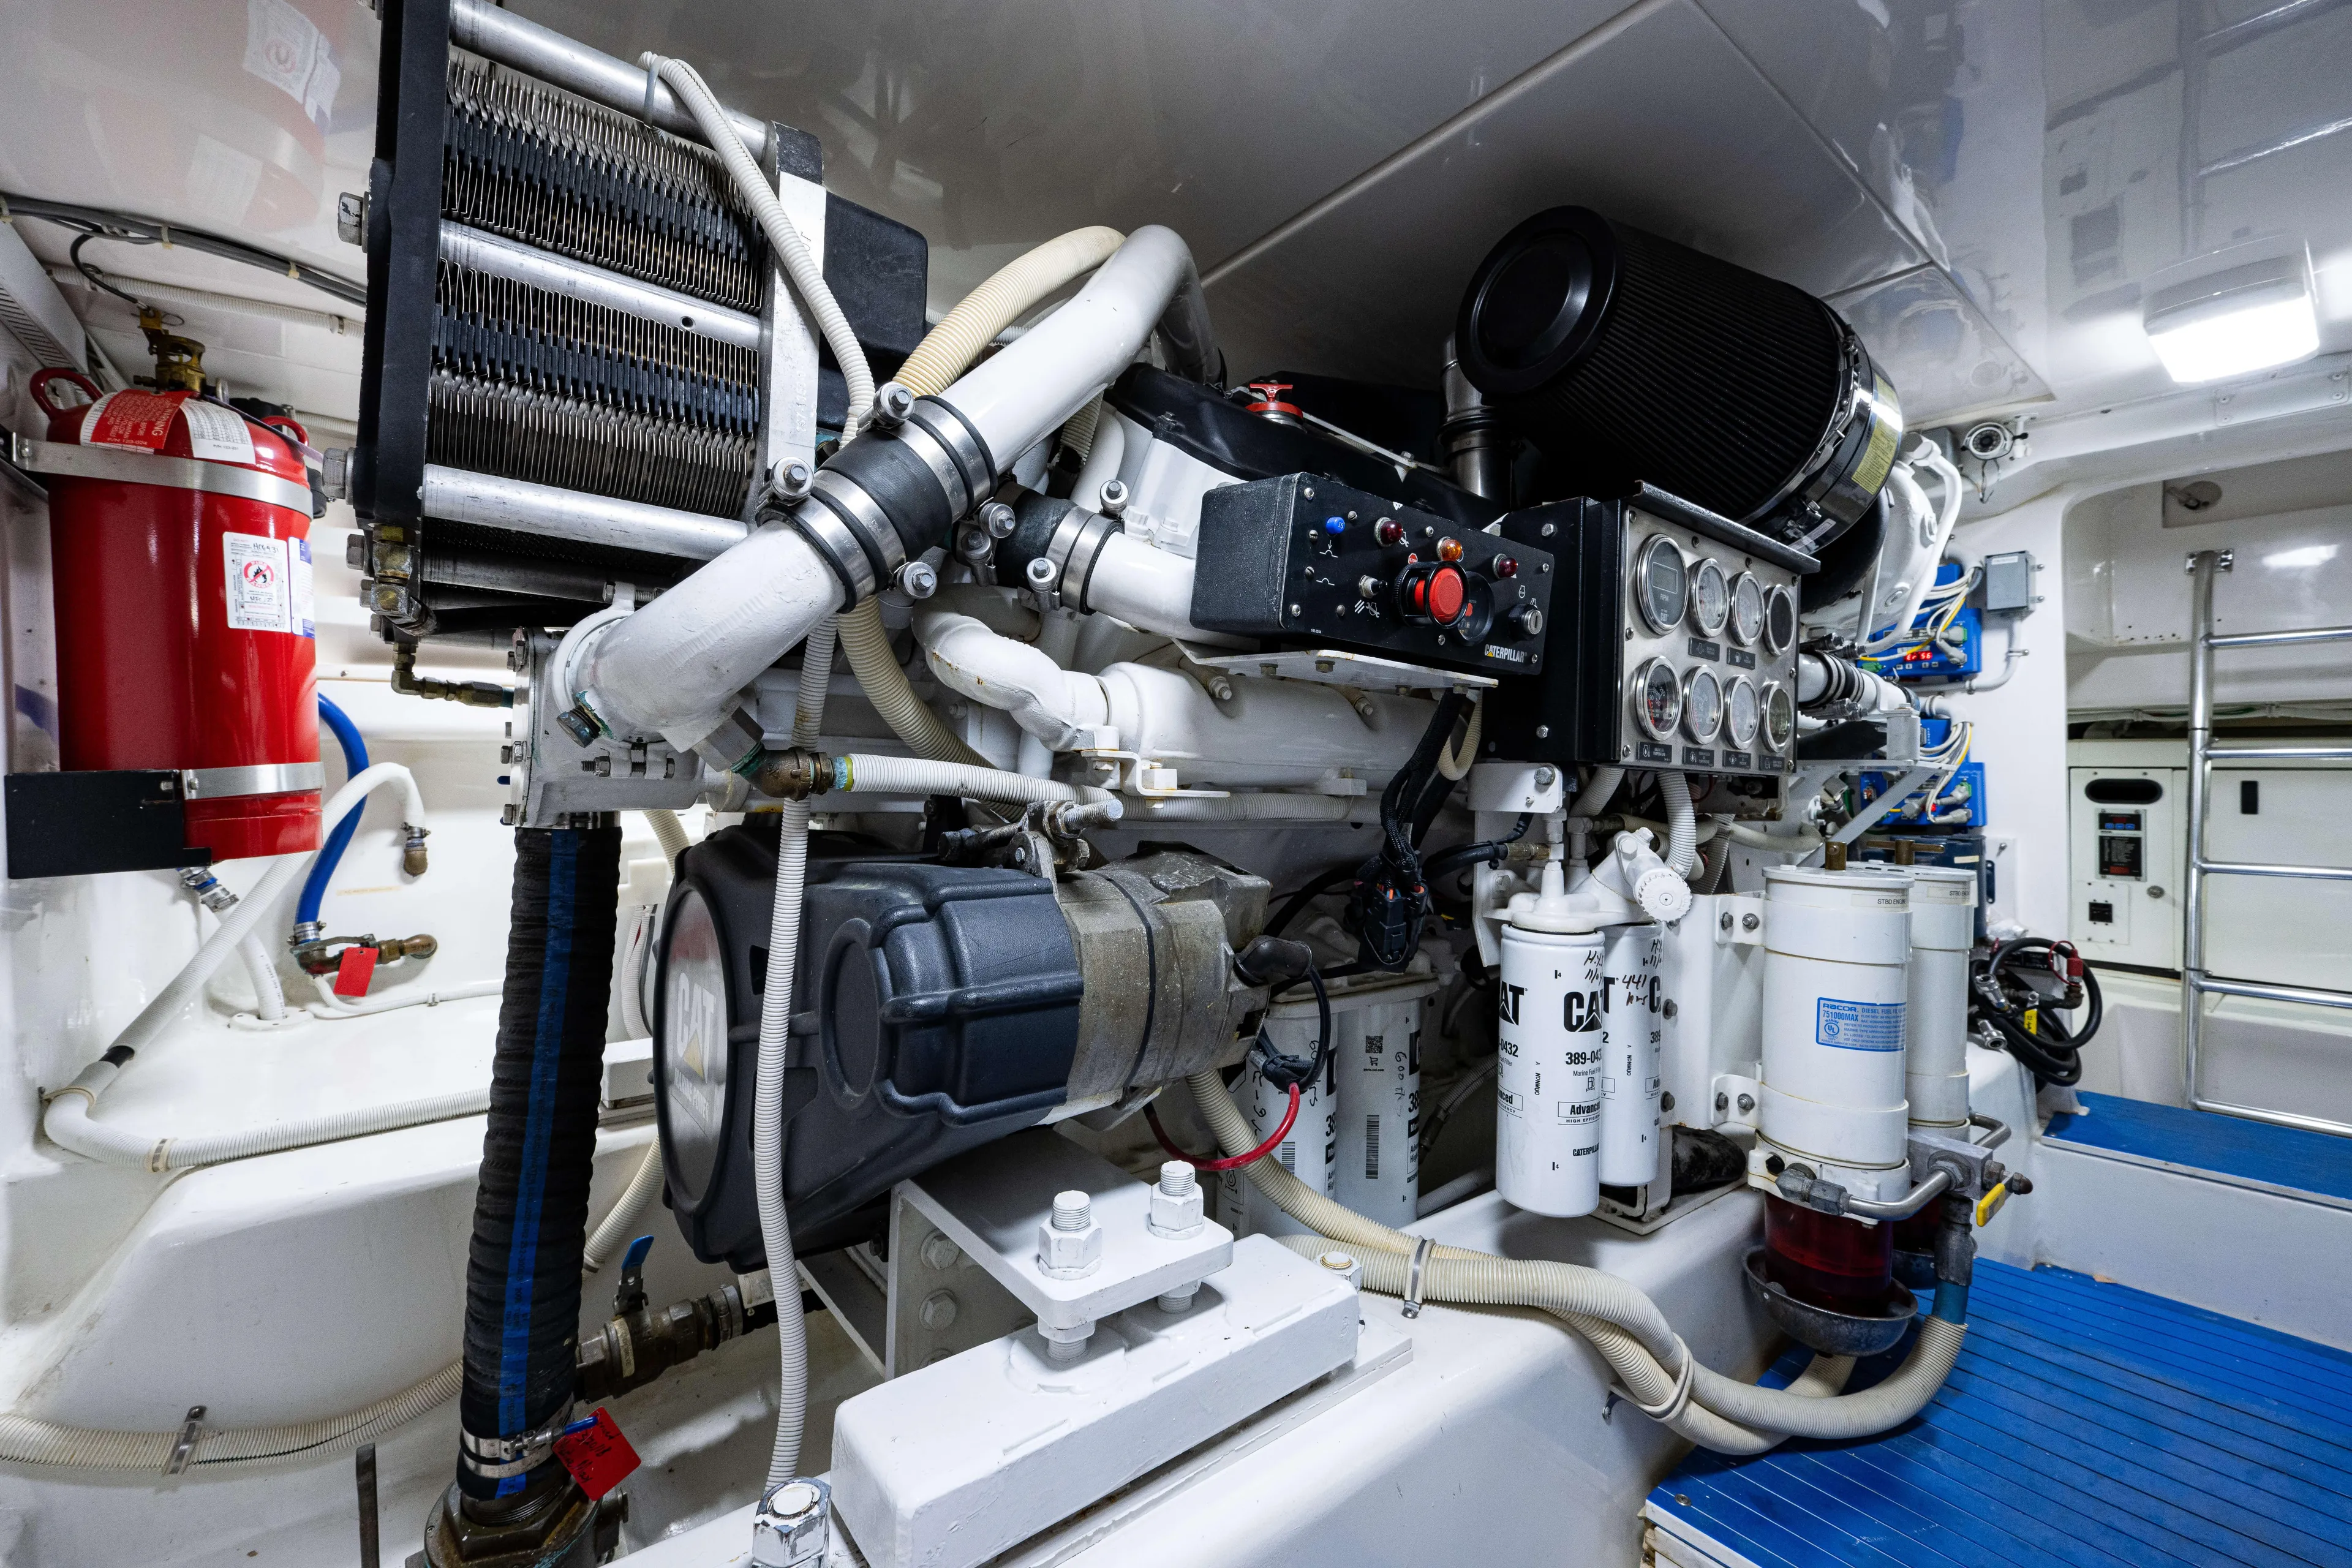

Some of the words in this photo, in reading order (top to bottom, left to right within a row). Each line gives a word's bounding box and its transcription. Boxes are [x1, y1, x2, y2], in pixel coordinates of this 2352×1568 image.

[1485, 644, 1525, 663] CATERPILLAR
[1622, 974, 1648, 990] 441
[1823, 1003, 1857, 1012] RACOR
[1823, 1010, 1859, 1022] 751000MAX
[677, 972, 716, 1084] CAT
[1828, 1025, 1836, 1033] UL
[674, 1066, 693, 1101] MARINE
[693, 1085, 709, 1122] POWER
